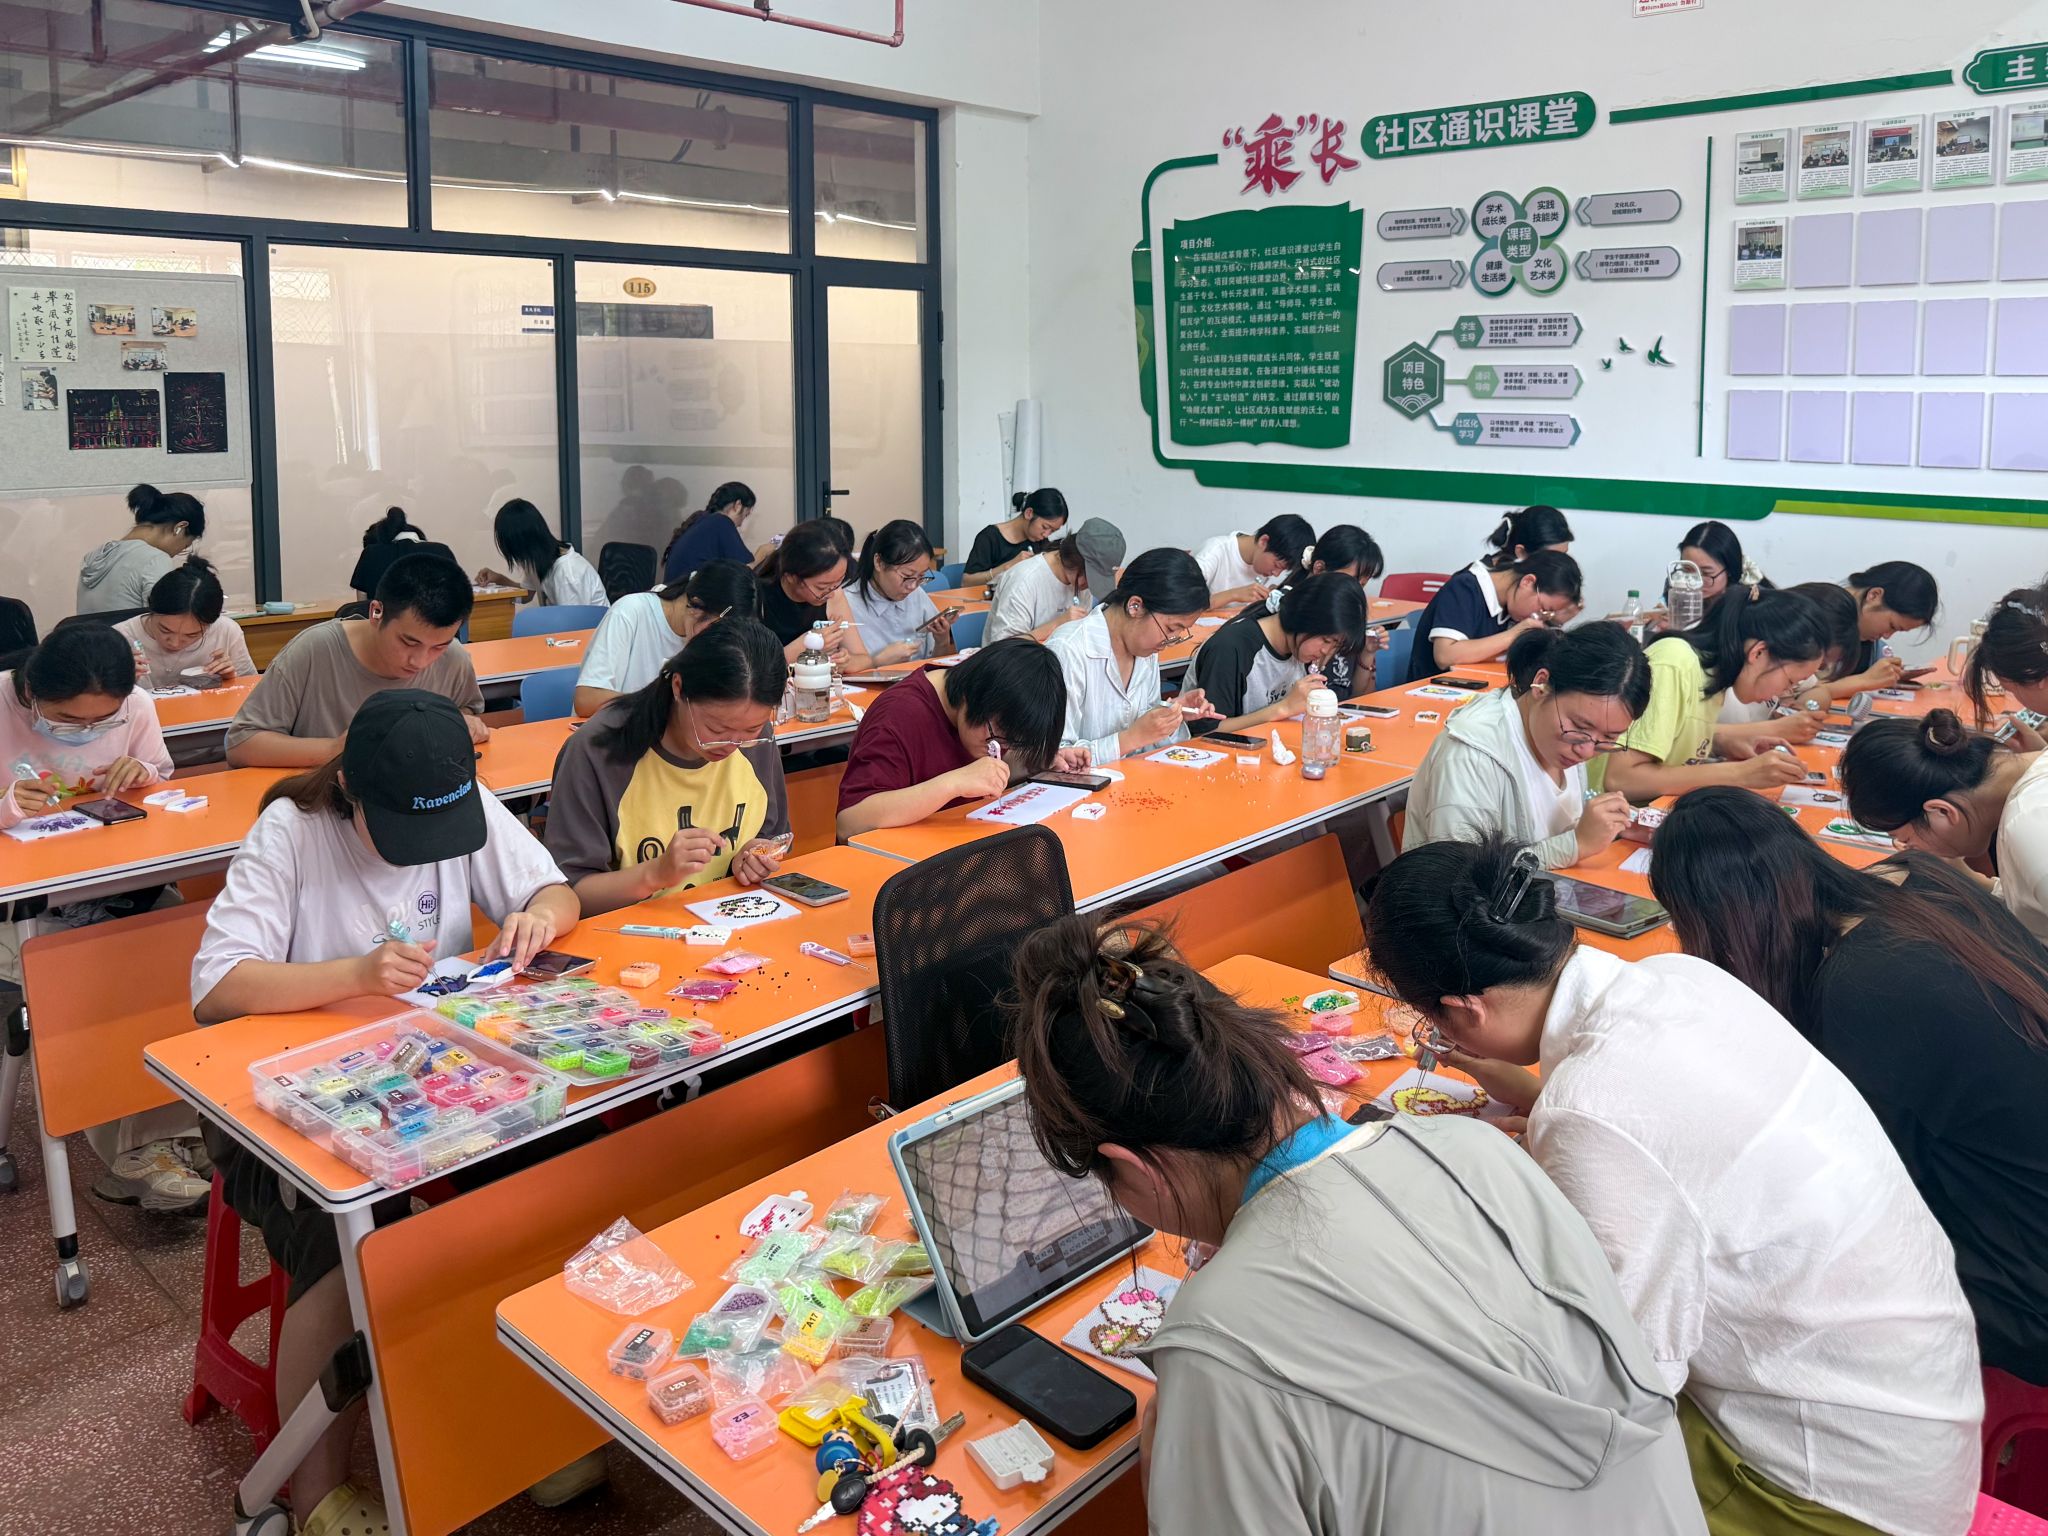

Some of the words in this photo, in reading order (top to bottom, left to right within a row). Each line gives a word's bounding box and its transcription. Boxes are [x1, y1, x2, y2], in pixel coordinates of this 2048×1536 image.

[1375, 97, 1578, 154] 社区通识课堂
[1486, 203, 1503, 214] 学术
[1537, 199, 1555, 211] 实践
[1481, 215, 1507, 227] 成长类
[1532, 211, 1559, 223] 技能类
[1507, 227, 1532, 241] 课程
[1506, 244, 1532, 259] 类型
[1485, 260, 1503, 271] 健康
[1534, 258, 1552, 269] 文化
[1481, 272, 1507, 283] 生活类
[1529, 269, 1556, 281] 艺术类
[629, 282, 651, 293] 115
[1403, 361, 1425, 374] 项目
[1402, 377, 1425, 390] 特色
[1455, 419, 1478, 428] 社区化
[1459, 430, 1474, 439] 学习
[412, 778, 472, 810] Ravenclaw
[421, 899, 434, 909] Hi!
[806, 1312, 819, 1328] A17
[634, 1330, 652, 1344] M15
[732, 1411, 751, 1423] E2
